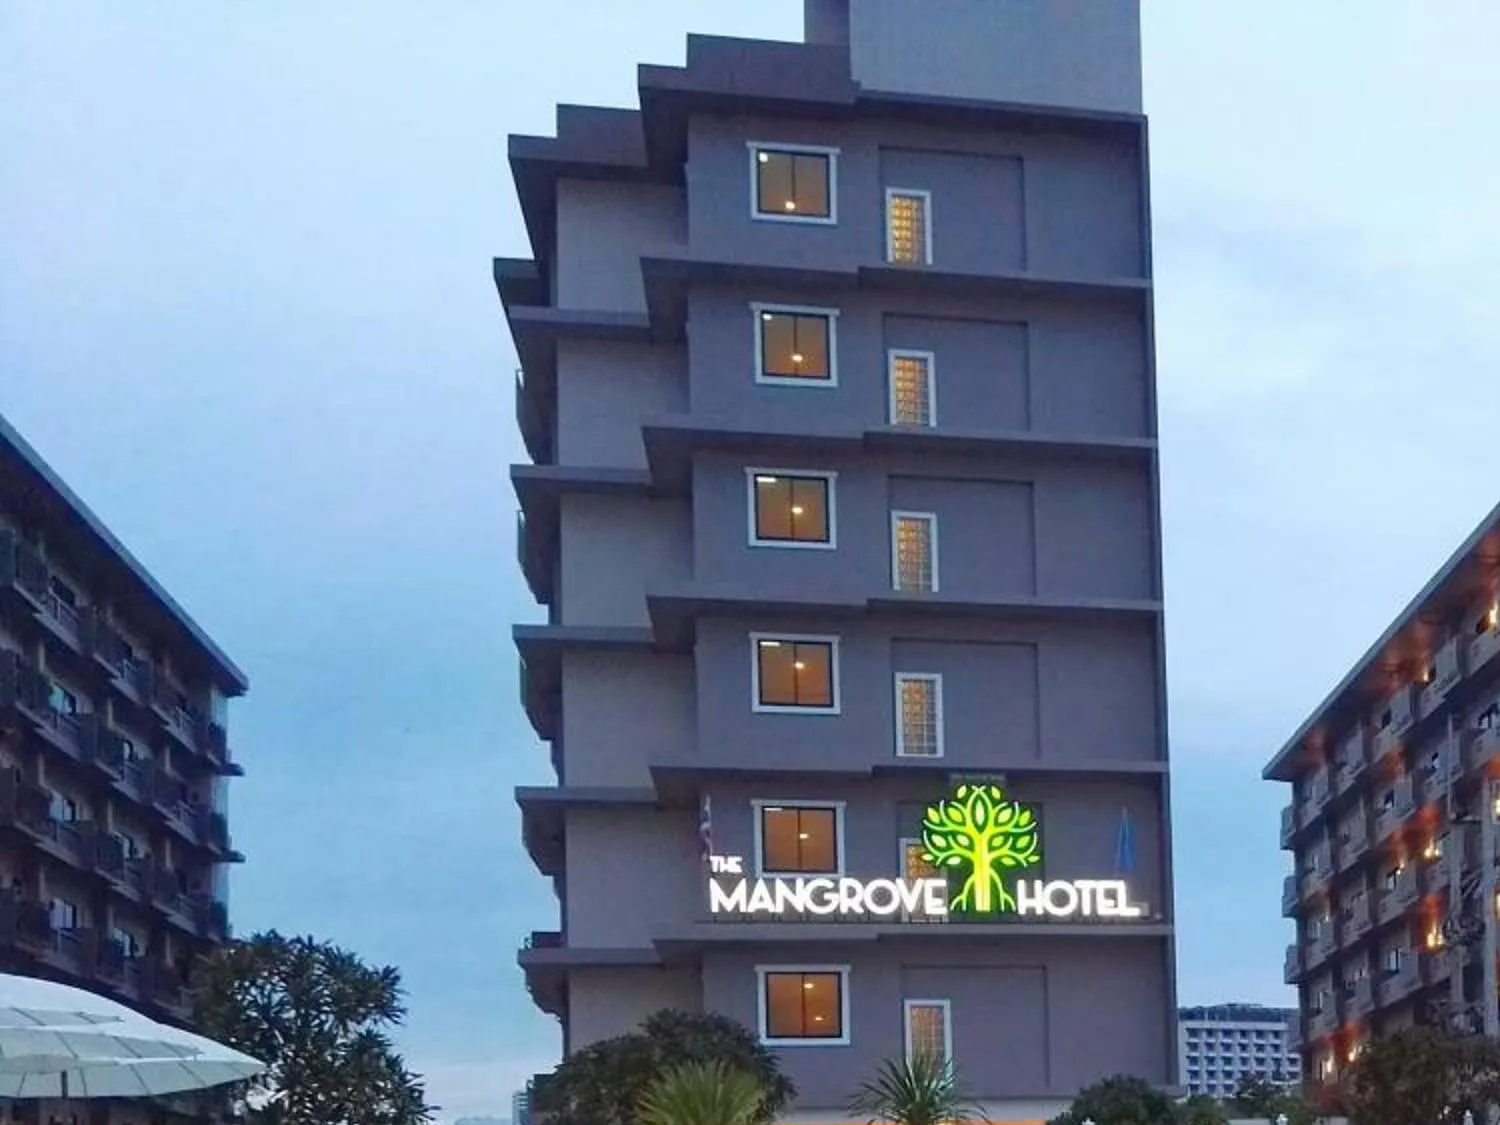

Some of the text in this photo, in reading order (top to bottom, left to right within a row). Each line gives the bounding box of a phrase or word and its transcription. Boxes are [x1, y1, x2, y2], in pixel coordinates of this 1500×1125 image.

[709, 855, 743, 873] THE
[709, 877, 1141, 917] MANGROVE HOTEL
